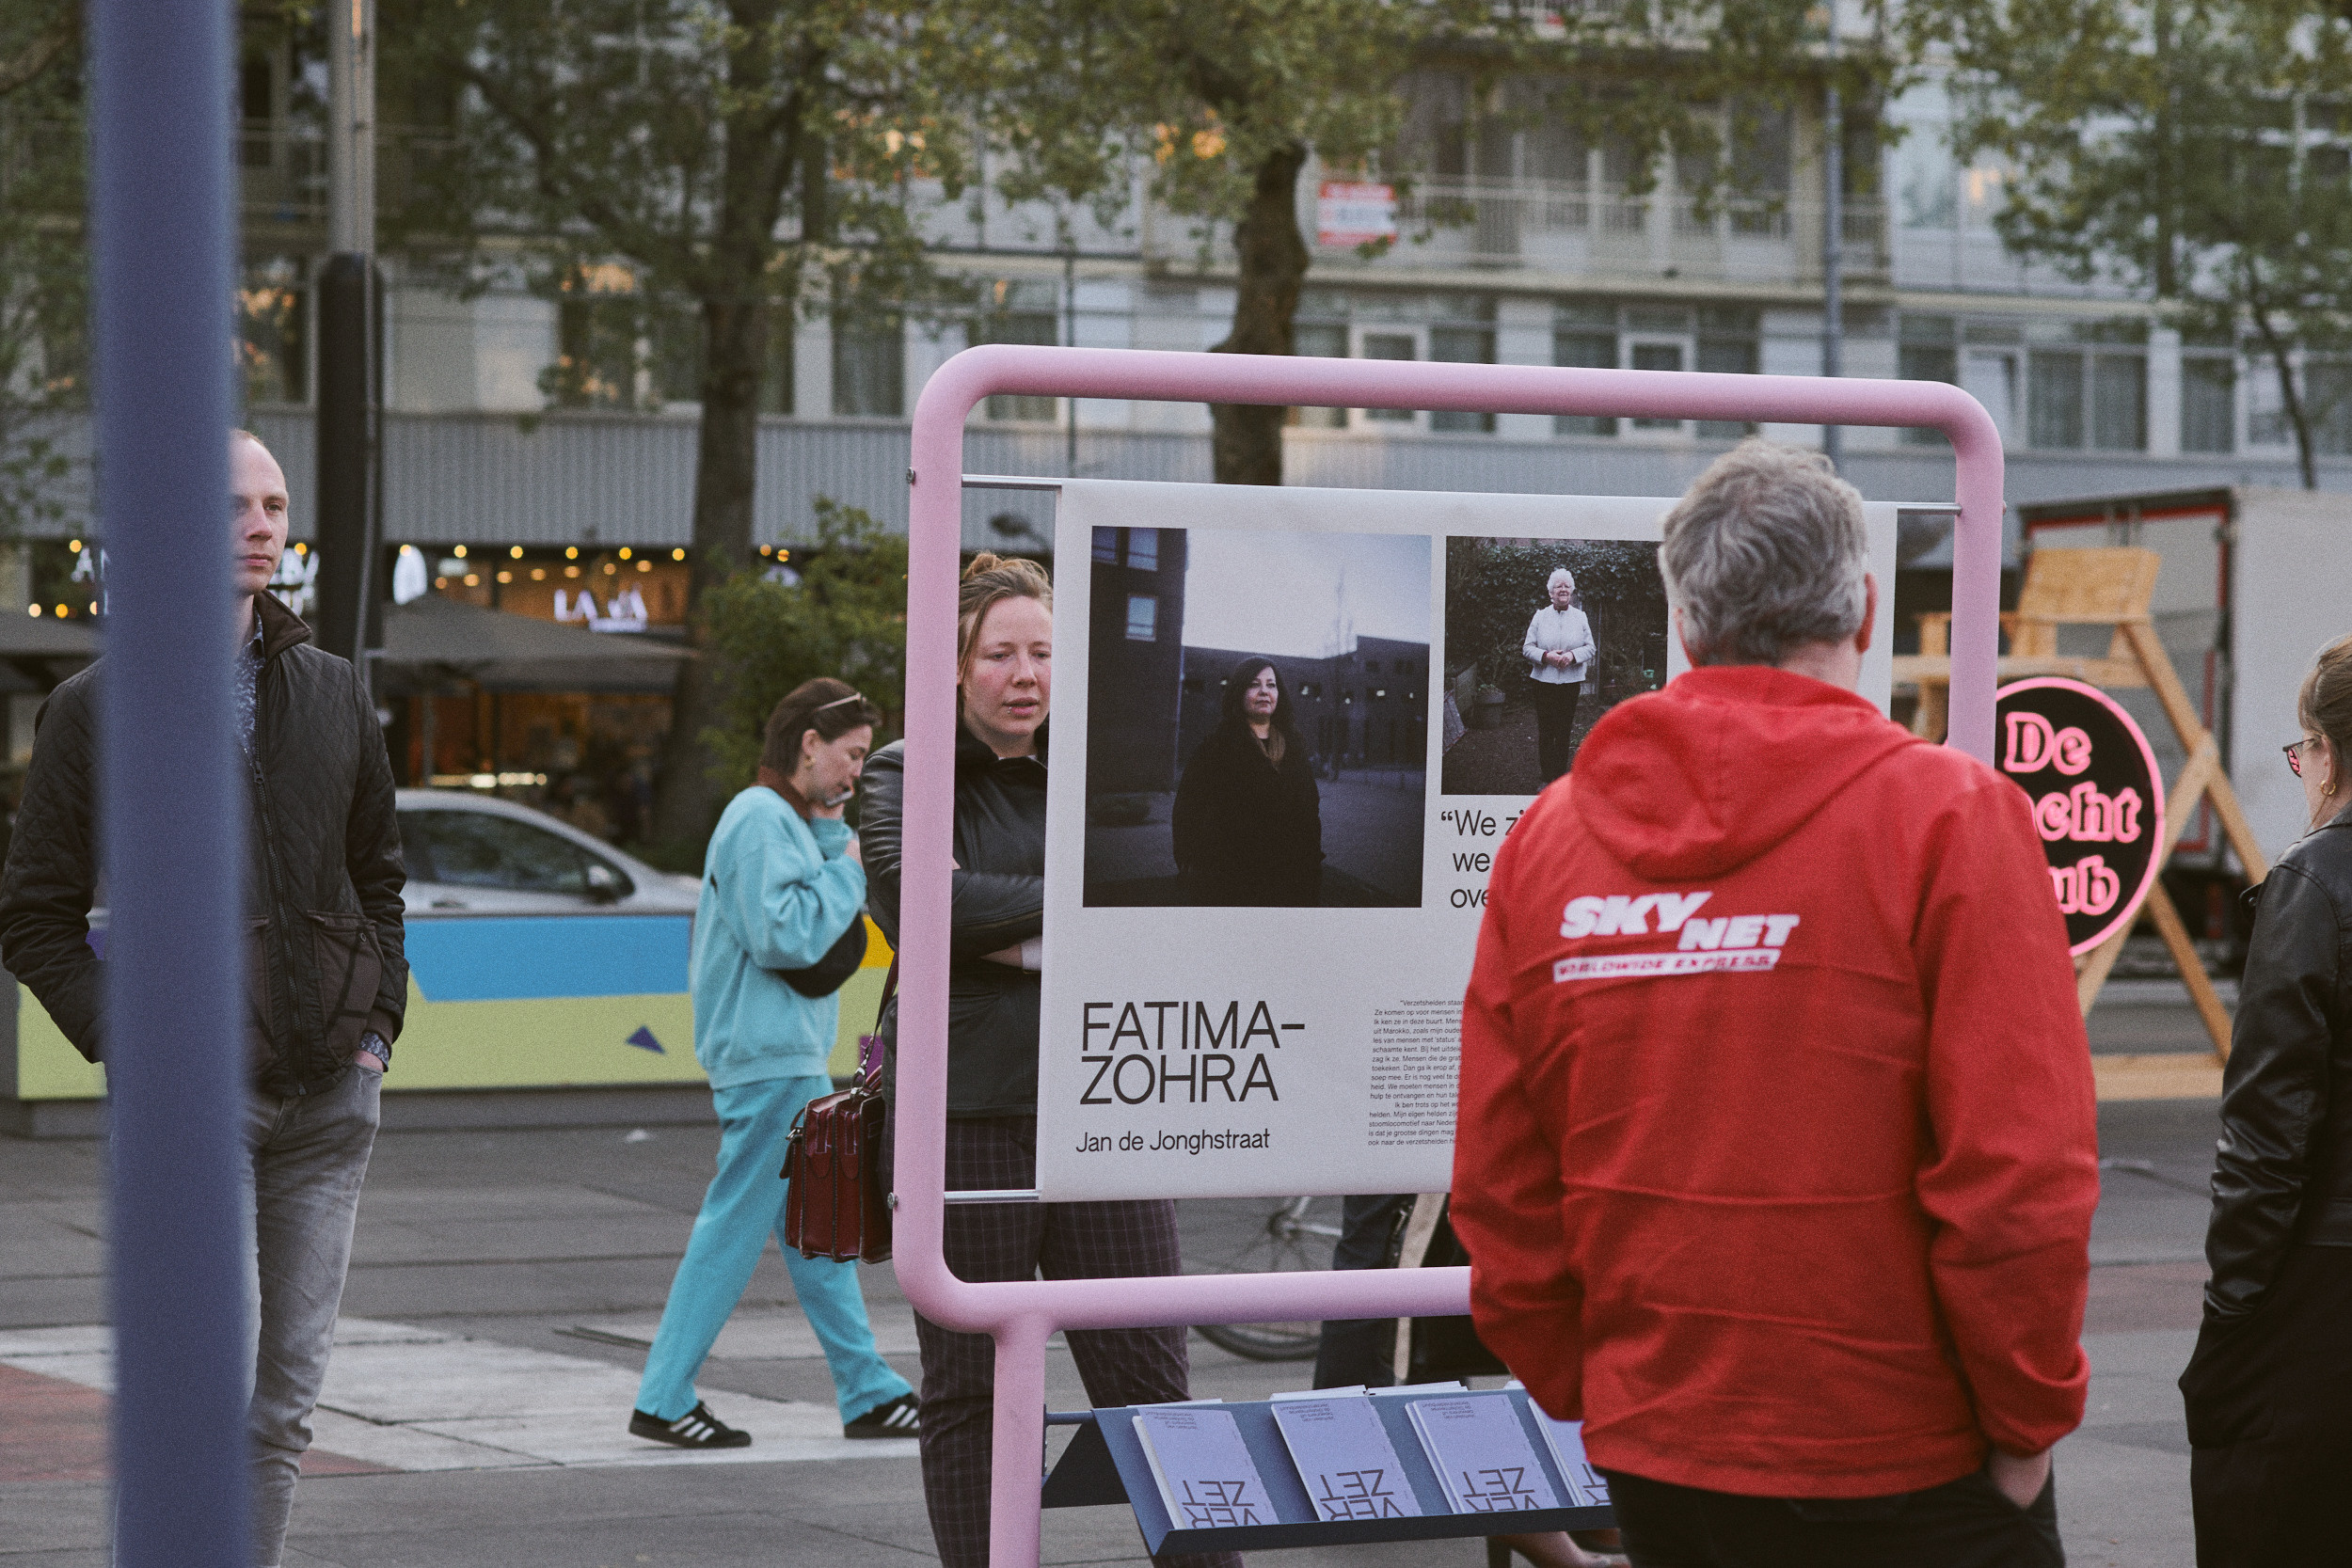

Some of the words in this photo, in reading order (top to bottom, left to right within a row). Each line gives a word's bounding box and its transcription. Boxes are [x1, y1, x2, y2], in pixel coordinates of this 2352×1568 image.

[2004, 711, 2092, 776] De
[1440, 809, 1497, 836] “We
[2035, 780, 2143, 844] cht
[1453, 852, 1490, 873] we
[2047, 854, 2121, 916] ub
[1082, 1000, 1306, 1052] FATIMA-
[1079, 1053, 1279, 1105] ZOHRA
[1392, 1092, 1425, 1101] ontvangen
[1075, 1132, 1112, 1153] Jan
[1119, 1131, 1144, 1151] de
[1149, 1128, 1271, 1156] Jonghstraat
[1418, 1129, 1439, 1137] dingen
[1182, 1480, 1255, 1507] ZET
[1319, 1468, 1394, 1502] ZET
[1463, 1466, 1535, 1499] ZET
